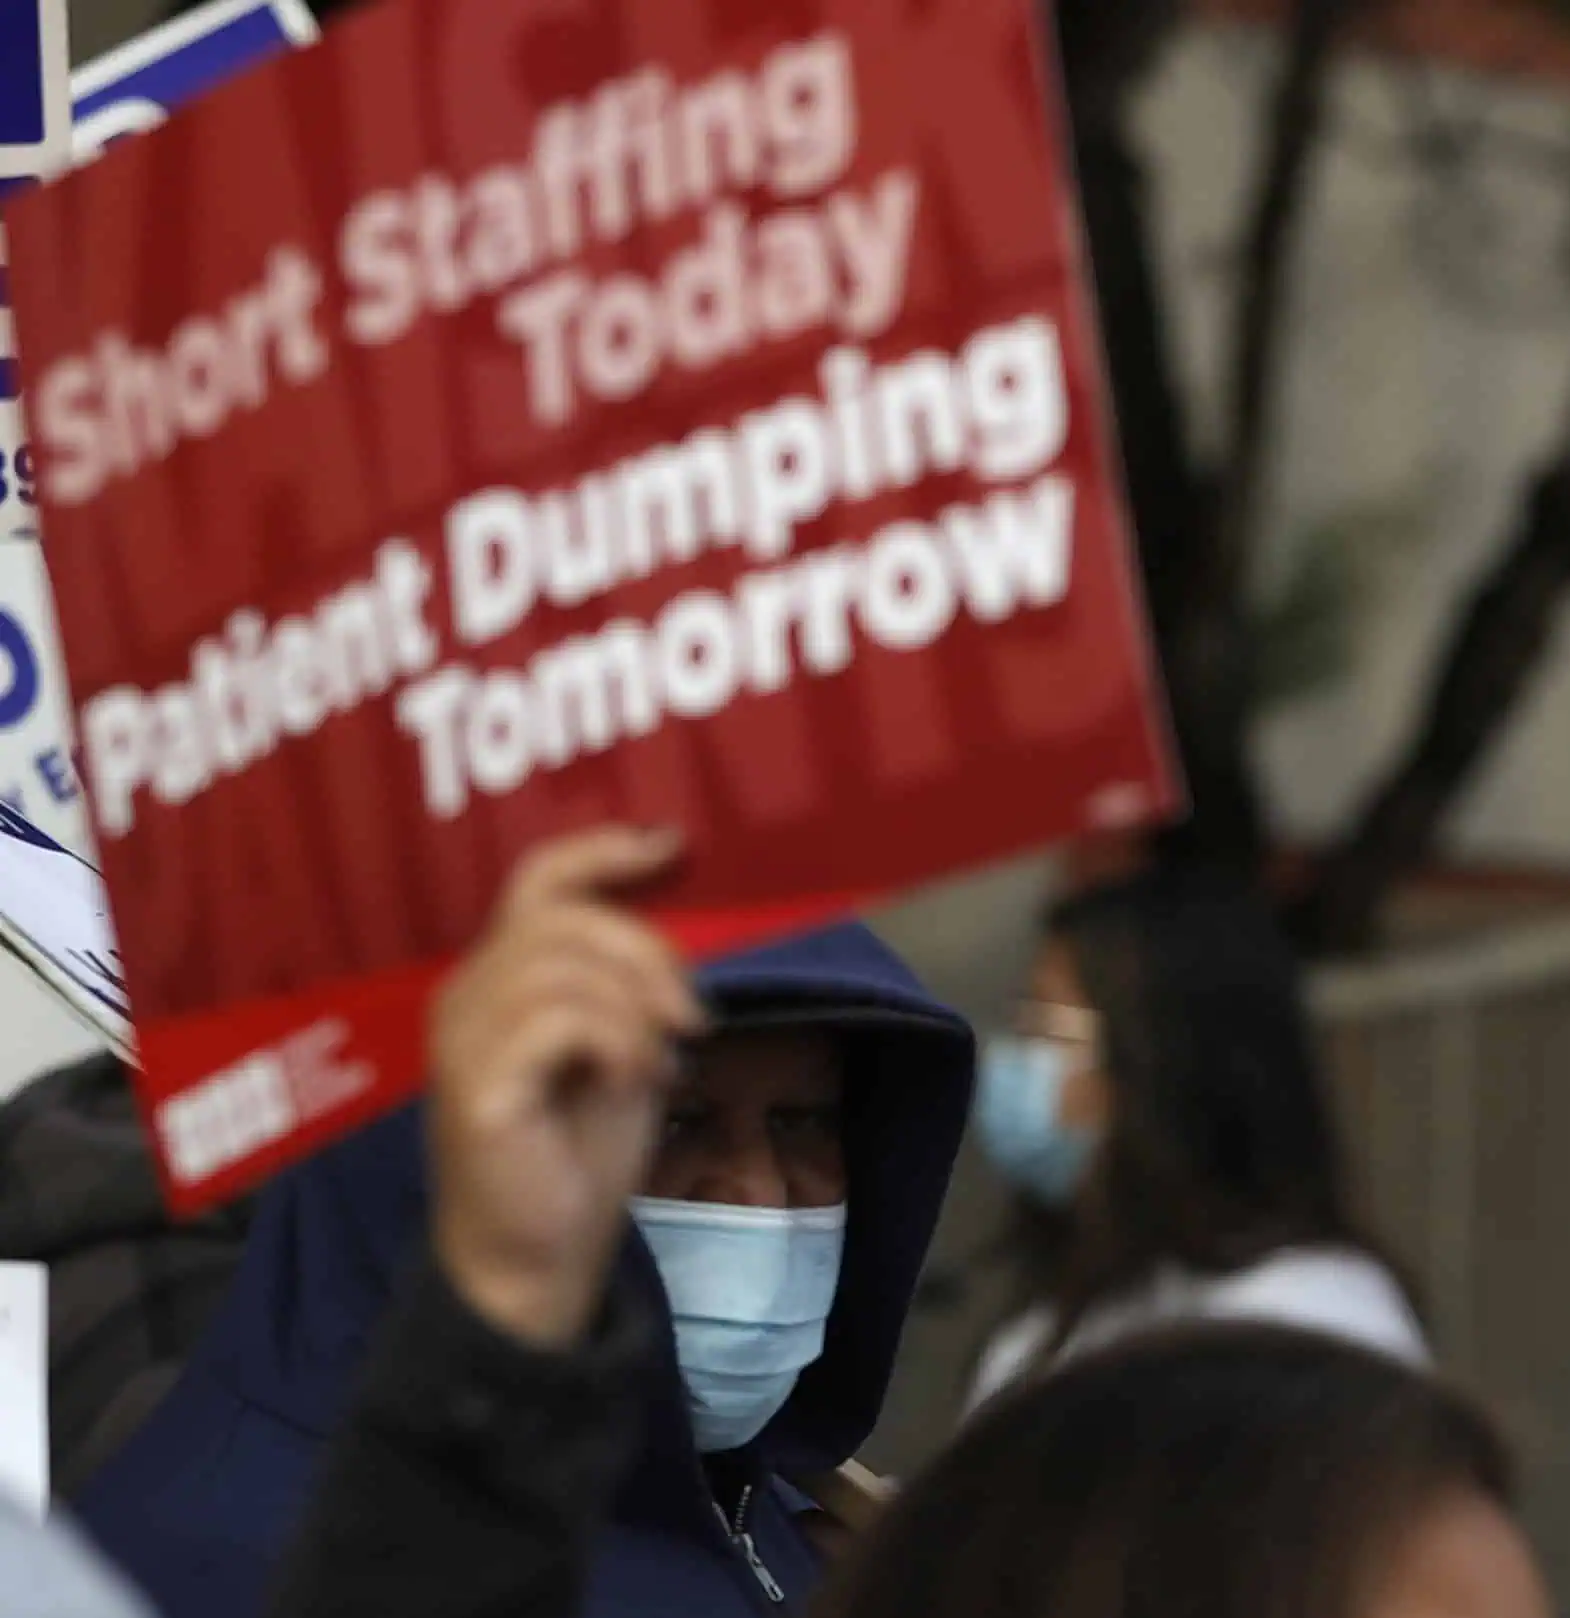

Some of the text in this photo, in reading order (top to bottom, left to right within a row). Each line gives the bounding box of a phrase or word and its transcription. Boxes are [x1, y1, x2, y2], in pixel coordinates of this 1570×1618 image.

[37, 34, 857, 506] Short Staffing
[498, 168, 921, 427] Today
[82, 313, 1066, 837] Patient Dumping
[398, 474, 1075, 817] Tomorrow
